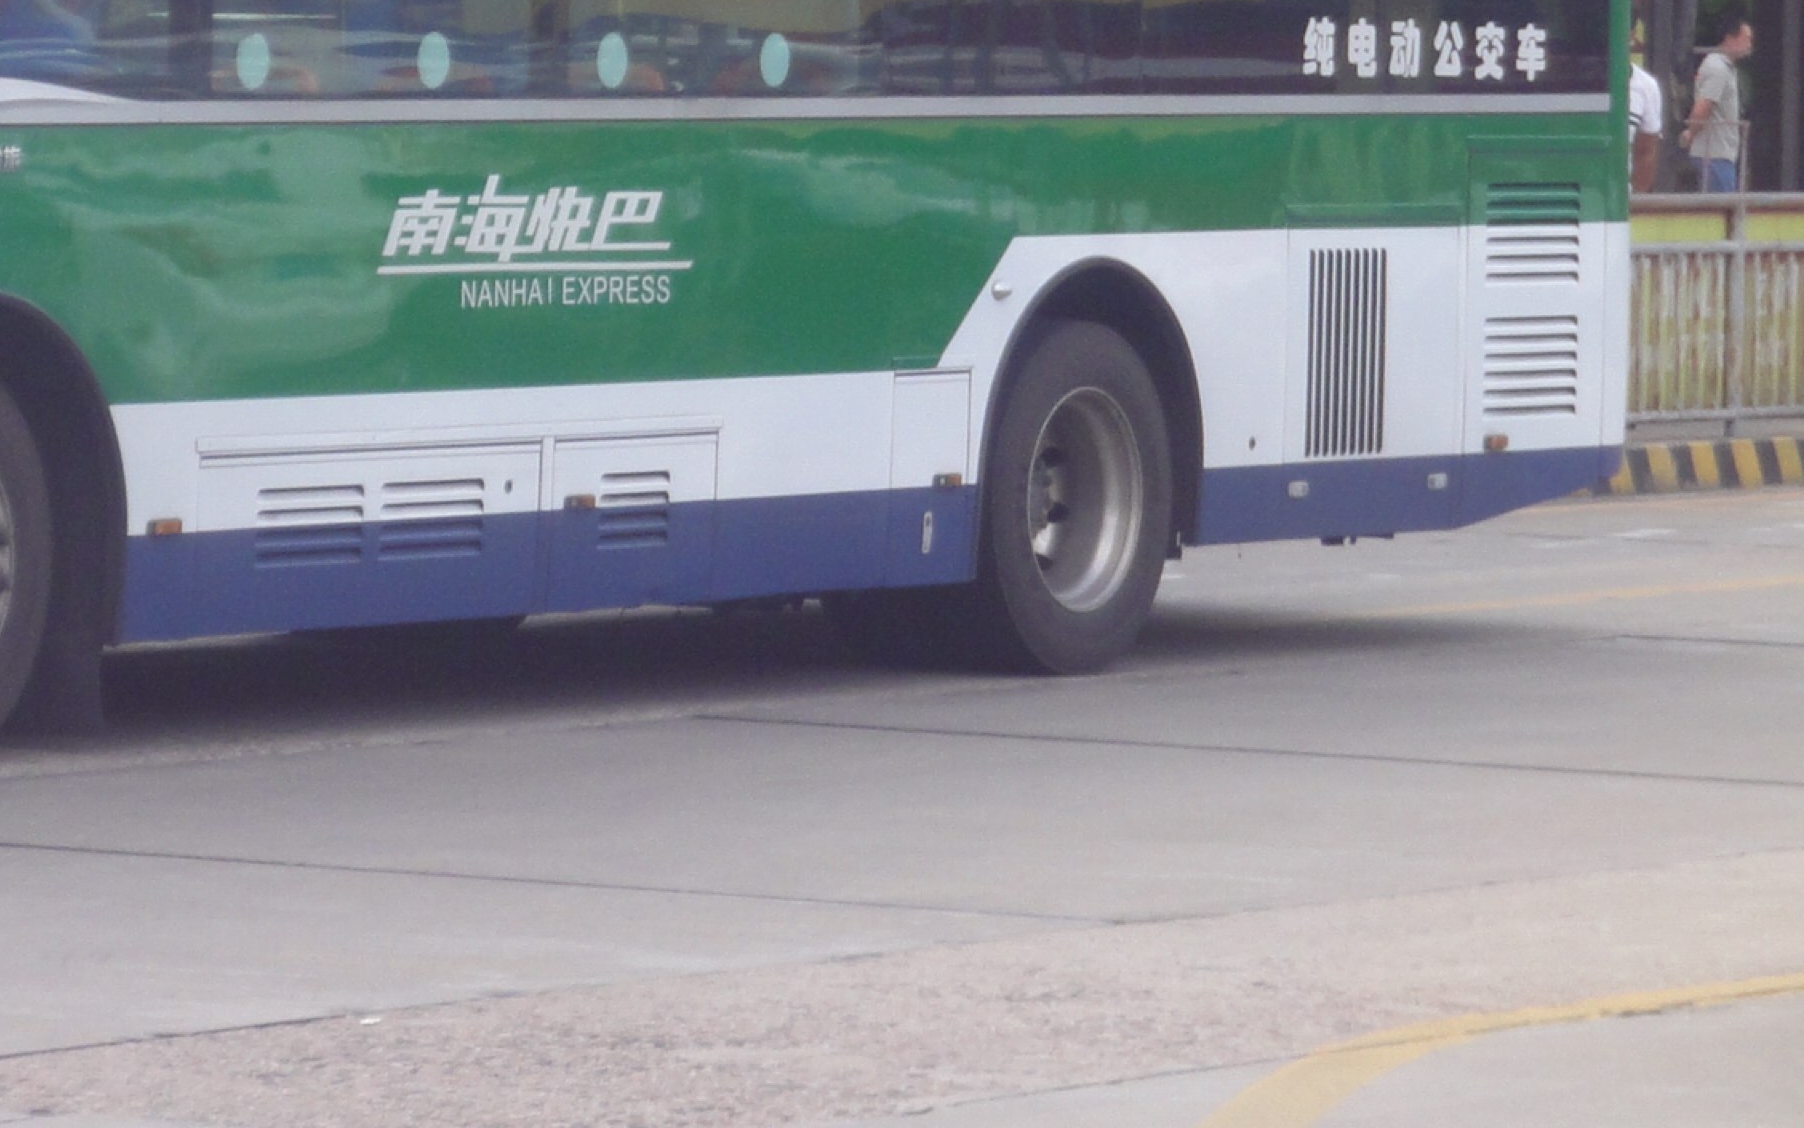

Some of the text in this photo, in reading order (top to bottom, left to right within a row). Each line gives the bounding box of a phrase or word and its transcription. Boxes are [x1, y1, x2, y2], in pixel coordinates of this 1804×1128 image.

[1303, 16, 1546, 81] 纯电动公交车
[381, 173, 671, 263] 南海快巴
[460, 274, 672, 308] NANHAI EXPRESS
